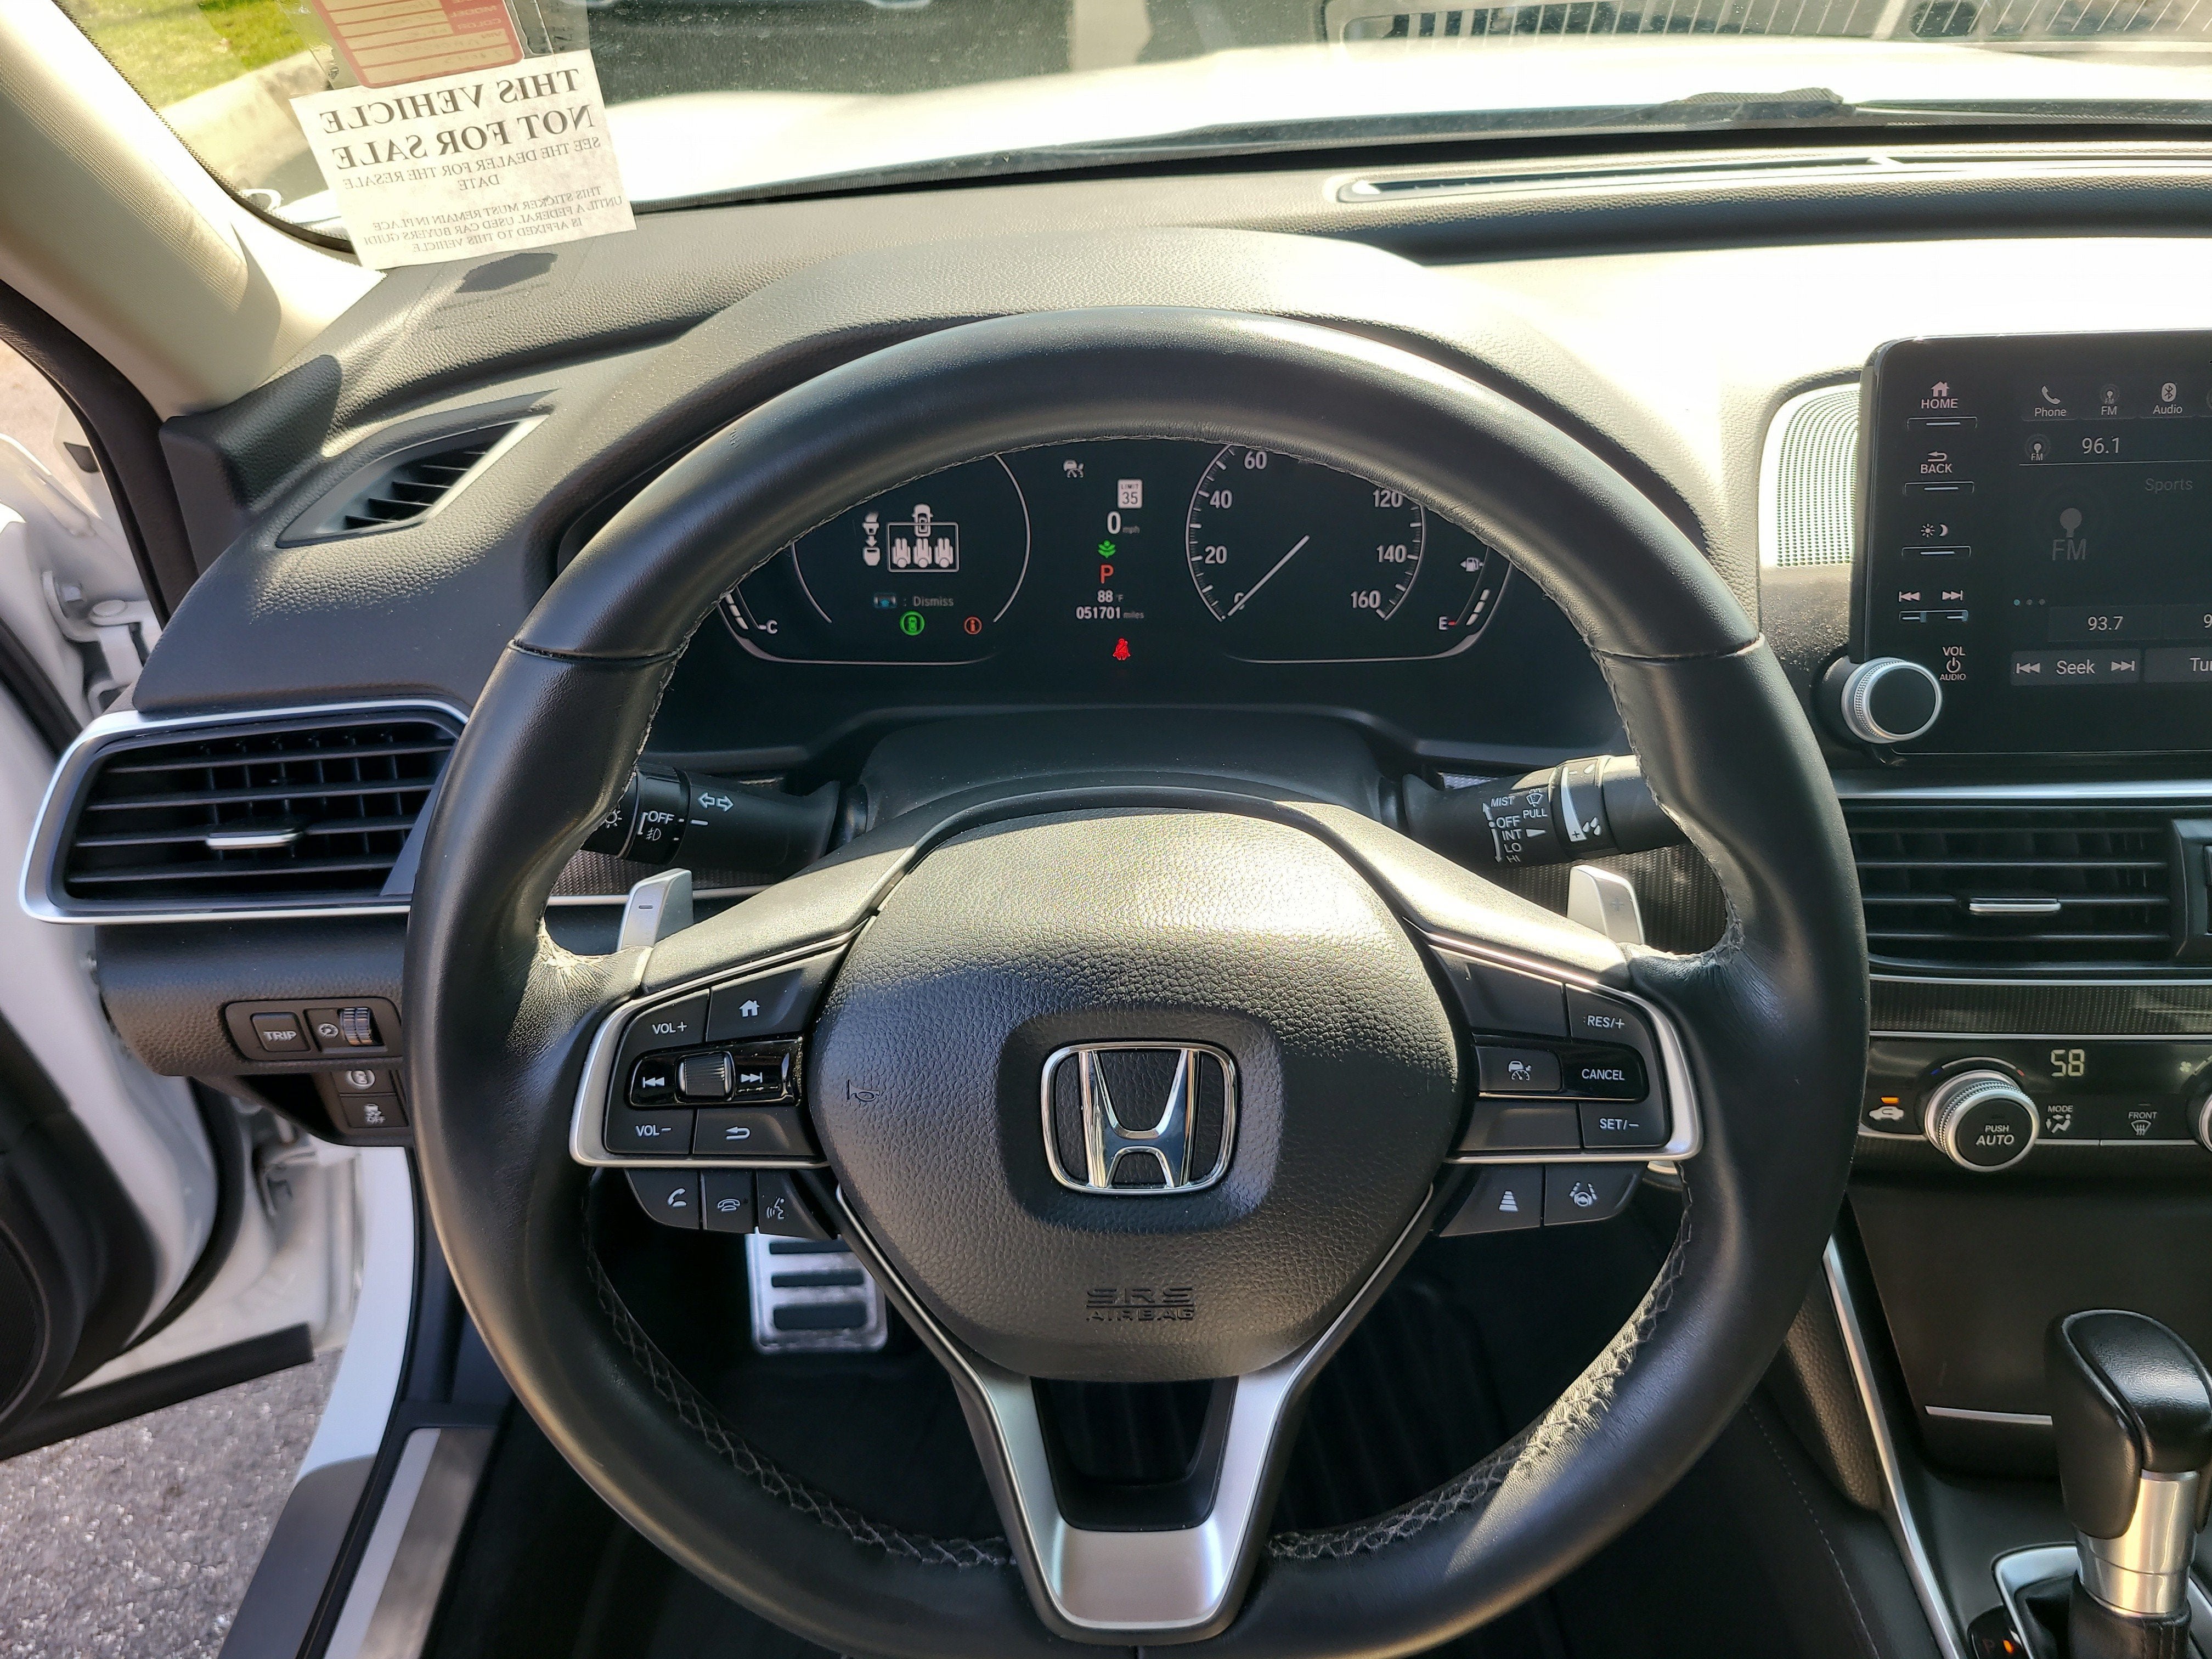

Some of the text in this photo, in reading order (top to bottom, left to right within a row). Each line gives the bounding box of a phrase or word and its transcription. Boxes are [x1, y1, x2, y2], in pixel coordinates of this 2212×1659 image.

[1921, 398, 1958, 409] HOME
[2152, 404, 2183, 414] Audio
[2034, 406, 2067, 417] Phone
[2101, 405, 2118, 415] FM
[2081, 437, 2120, 454] 96.1
[1244, 450, 1267, 470] 60
[2031, 453, 2043, 461] FM
[1920, 463, 1953, 475] BACK
[2145, 477, 2193, 493] Sports
[1122, 492, 1138, 505] 35
[1210, 490, 1233, 509] 40
[1373, 489, 1403, 508] 120
[1106, 511, 1121, 534] 0
[1204, 545, 1228, 565] 20
[1376, 545, 1407, 563] 140
[2052, 539, 2086, 561] FM
[1100, 563, 1114, 584] P
[913, 595, 955, 607] Dismiss
[1097, 590, 1114, 603] 88
[1350, 590, 1381, 609] 160
[1076, 606, 1144, 619] 051701 miles
[766, 619, 778, 634] C
[1438, 616, 1448, 630] E
[2087, 616, 2124, 631] 93.7
[1942, 646, 1966, 656] VOL
[2056, 660, 2095, 675] Seek
[1939, 673, 1966, 681] AUDIO
[1491, 796, 1515, 807] MIST
[647, 810, 674, 823] OFF
[1522, 808, 1548, 819] PULL
[1496, 815, 1520, 827] OFF
[1502, 829, 1522, 840] INT
[1504, 843, 1522, 853] LO
[1506, 855, 1521, 864] HI
[263, 1030, 297, 1041] TRIP
[2051, 1048, 2085, 1077] 58
[1582, 1069, 1625, 1081] CANCEL
[2047, 1105, 2073, 1113] MODE
[2128, 1111, 2158, 1119] FRONT
[1984, 1125, 2010, 1133] PUSH
[1976, 1135, 2015, 1146] AUTO
[1086, 1286, 1194, 1305] SRS
[1086, 1309, 1194, 1321] AIRBAG
